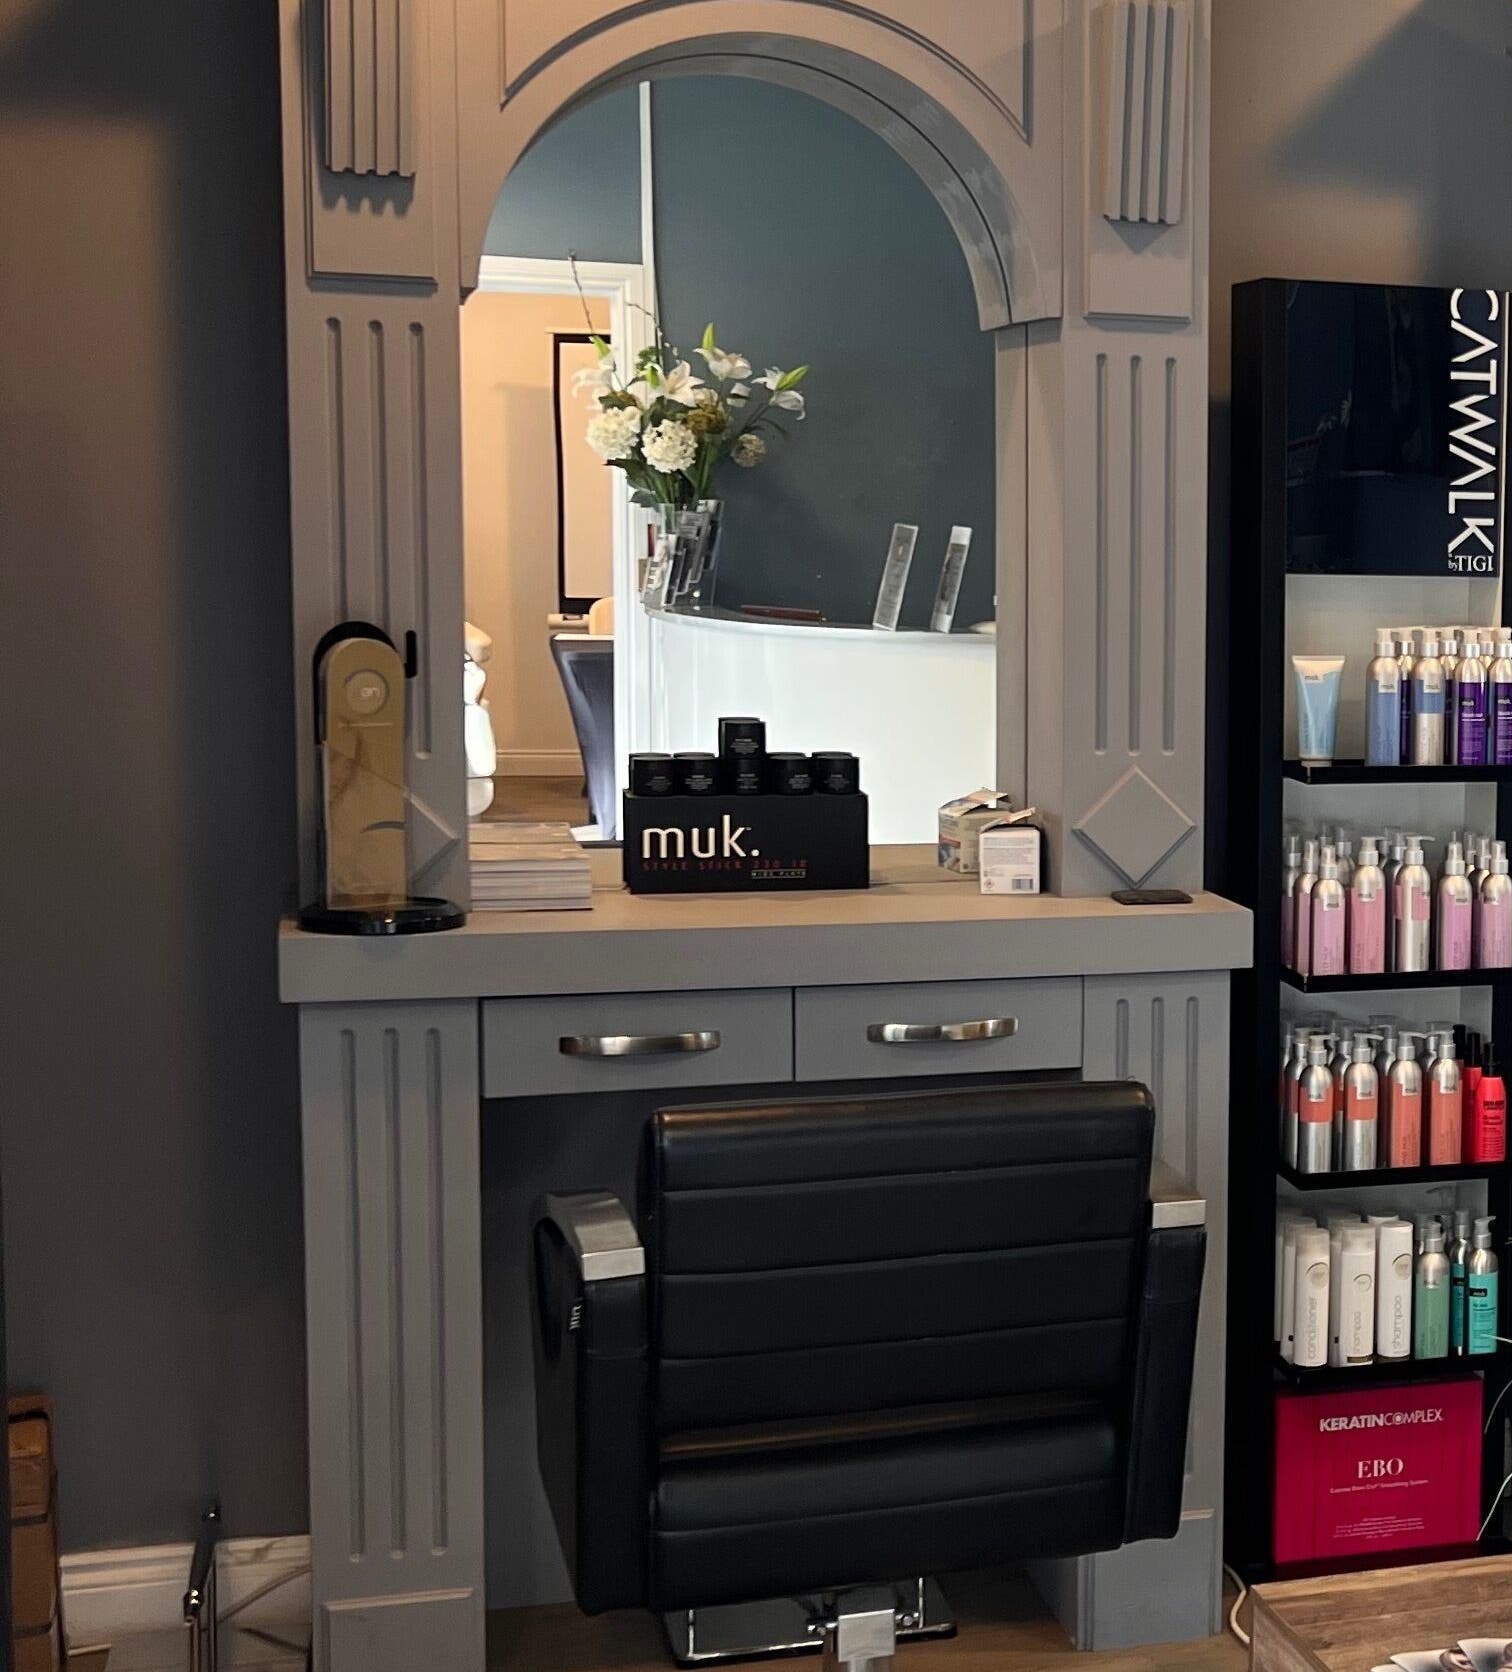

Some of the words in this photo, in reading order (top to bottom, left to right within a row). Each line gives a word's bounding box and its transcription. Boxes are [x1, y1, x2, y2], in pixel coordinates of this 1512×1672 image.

[1447, 288, 1499, 554] CATWALK
[1455, 555, 1494, 572] TIGI
[1393, 1295, 1403, 1349] shampoo
[1357, 1457, 1404, 1479] EBO
